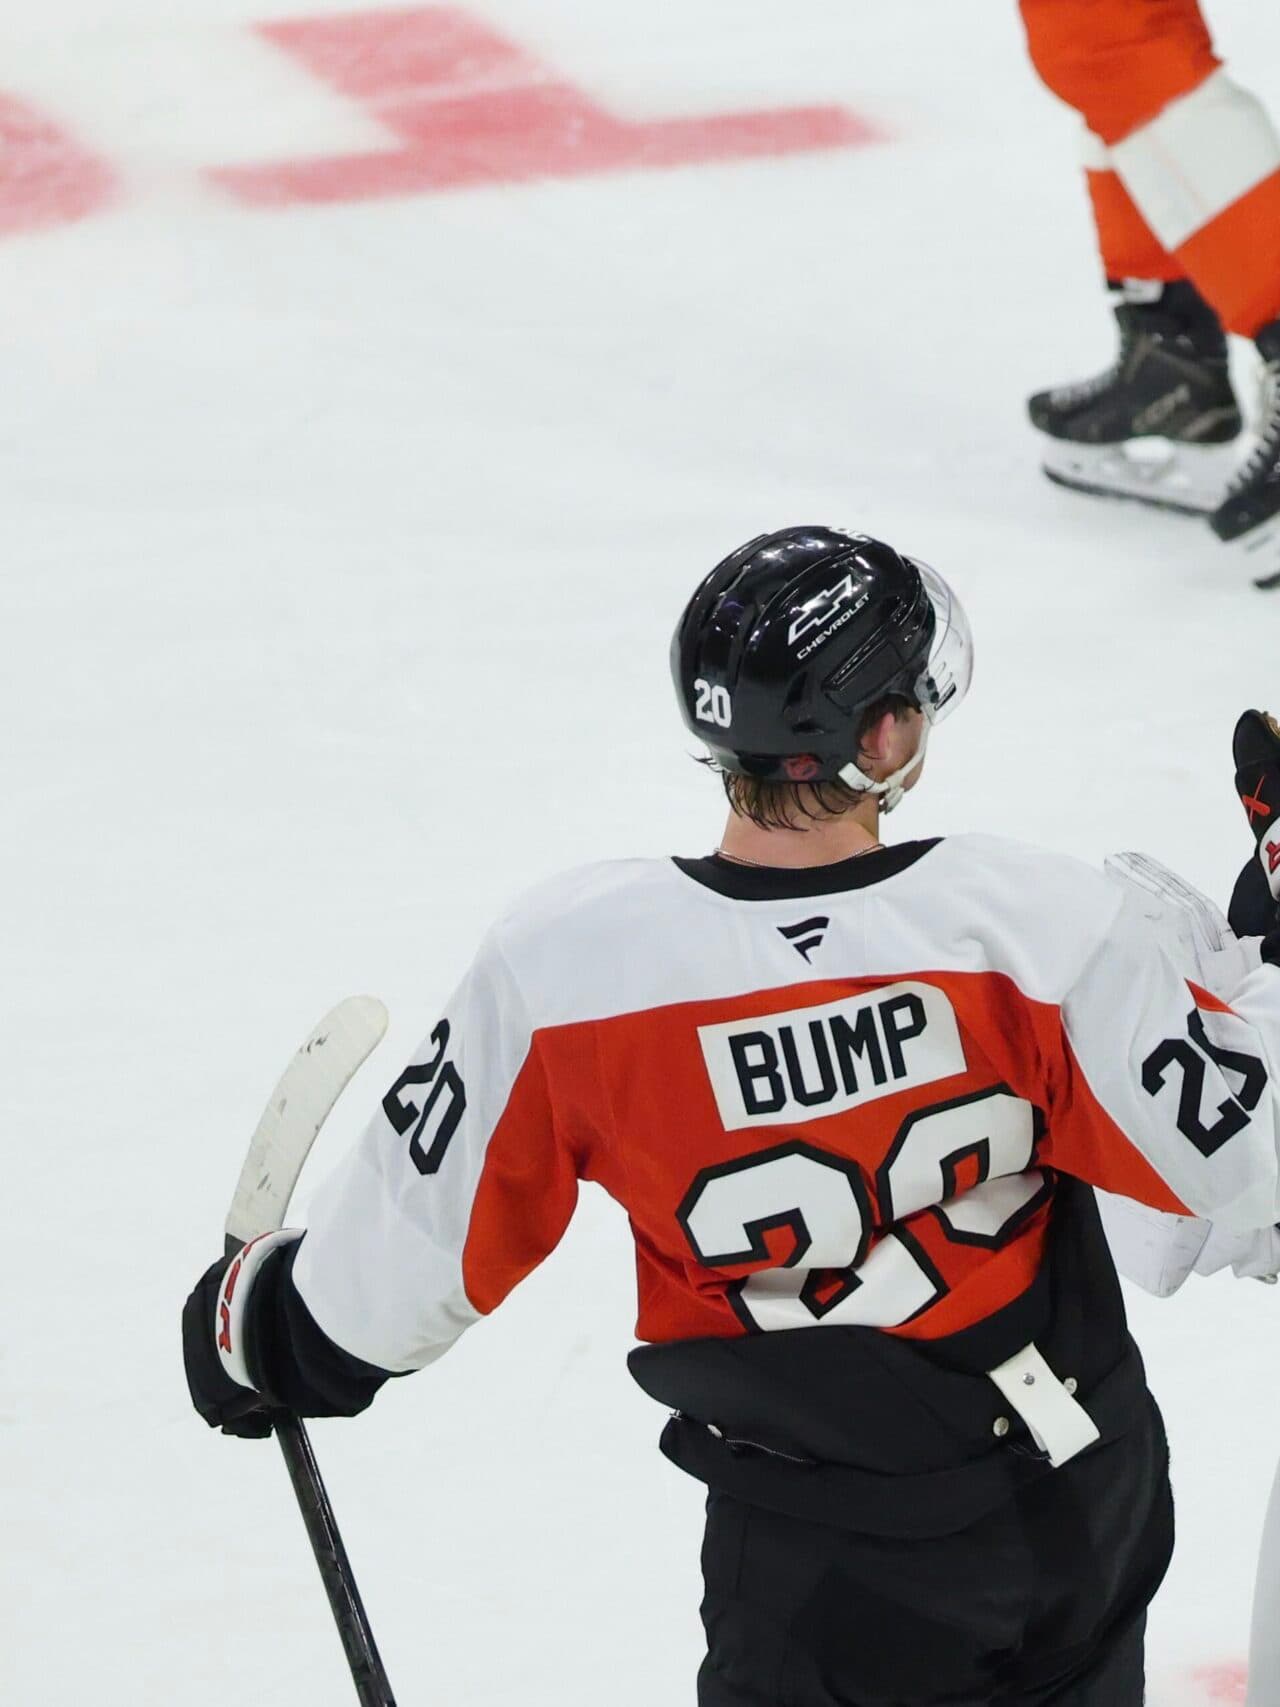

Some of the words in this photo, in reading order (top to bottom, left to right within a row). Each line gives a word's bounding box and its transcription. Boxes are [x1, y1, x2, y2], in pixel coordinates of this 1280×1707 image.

[796, 592, 871, 661] CHEVROLET
[693, 677, 733, 729] 20
[382, 1017, 467, 1176] 20
[727, 991, 929, 1117] BUMP
[1140, 1007, 1268, 1159] 20
